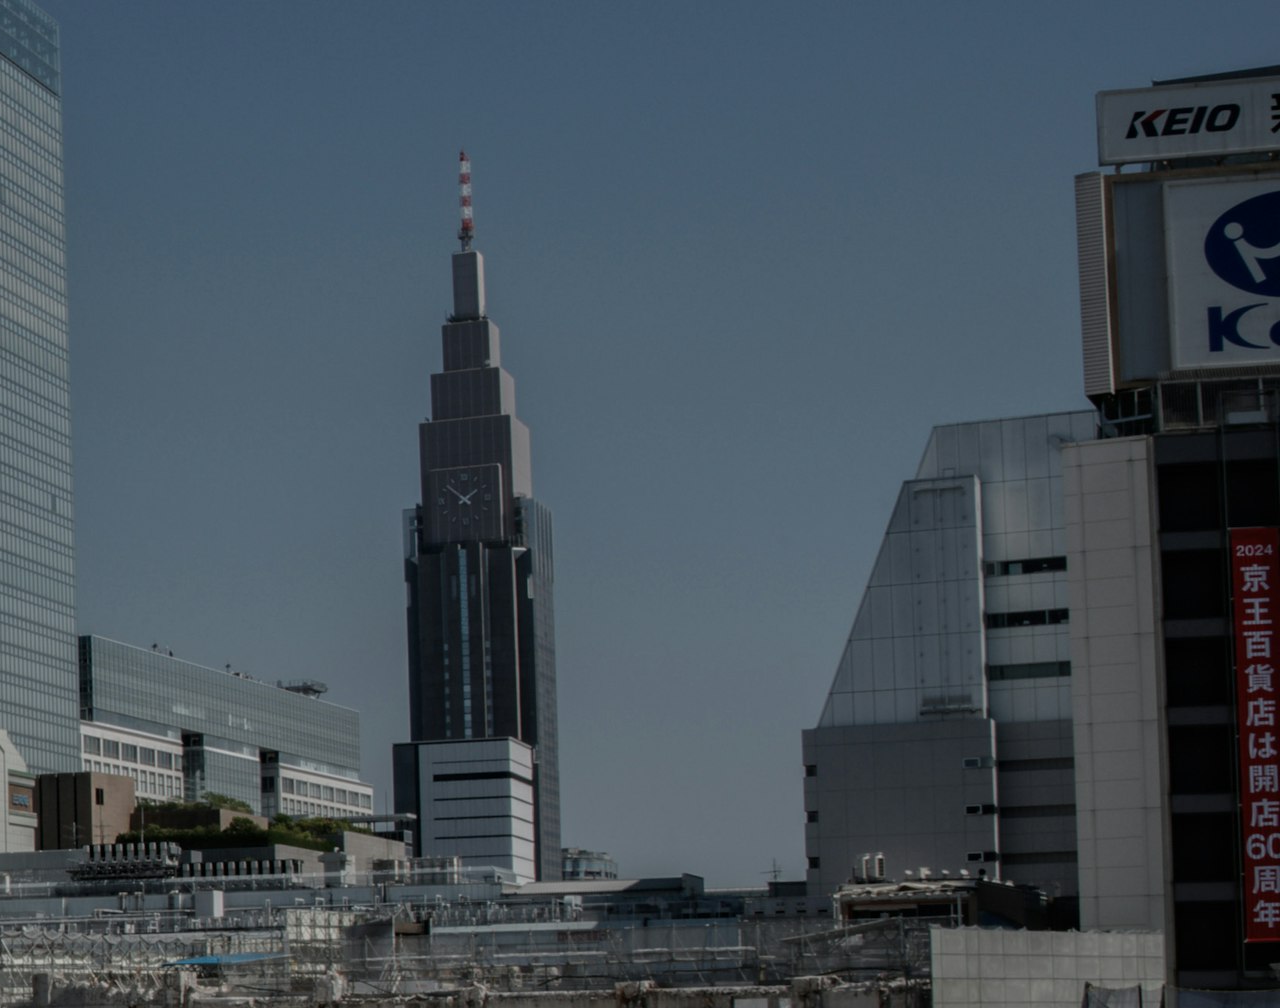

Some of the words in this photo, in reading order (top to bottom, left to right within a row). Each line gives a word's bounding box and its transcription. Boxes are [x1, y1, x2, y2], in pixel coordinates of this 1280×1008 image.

[1125, 103, 1240, 139] KEIO
[1208, 302, 1280, 352] K
[1236, 543, 1274, 557] 2024
[1239, 563, 1280, 928] 京王百貨店は開店60周年
